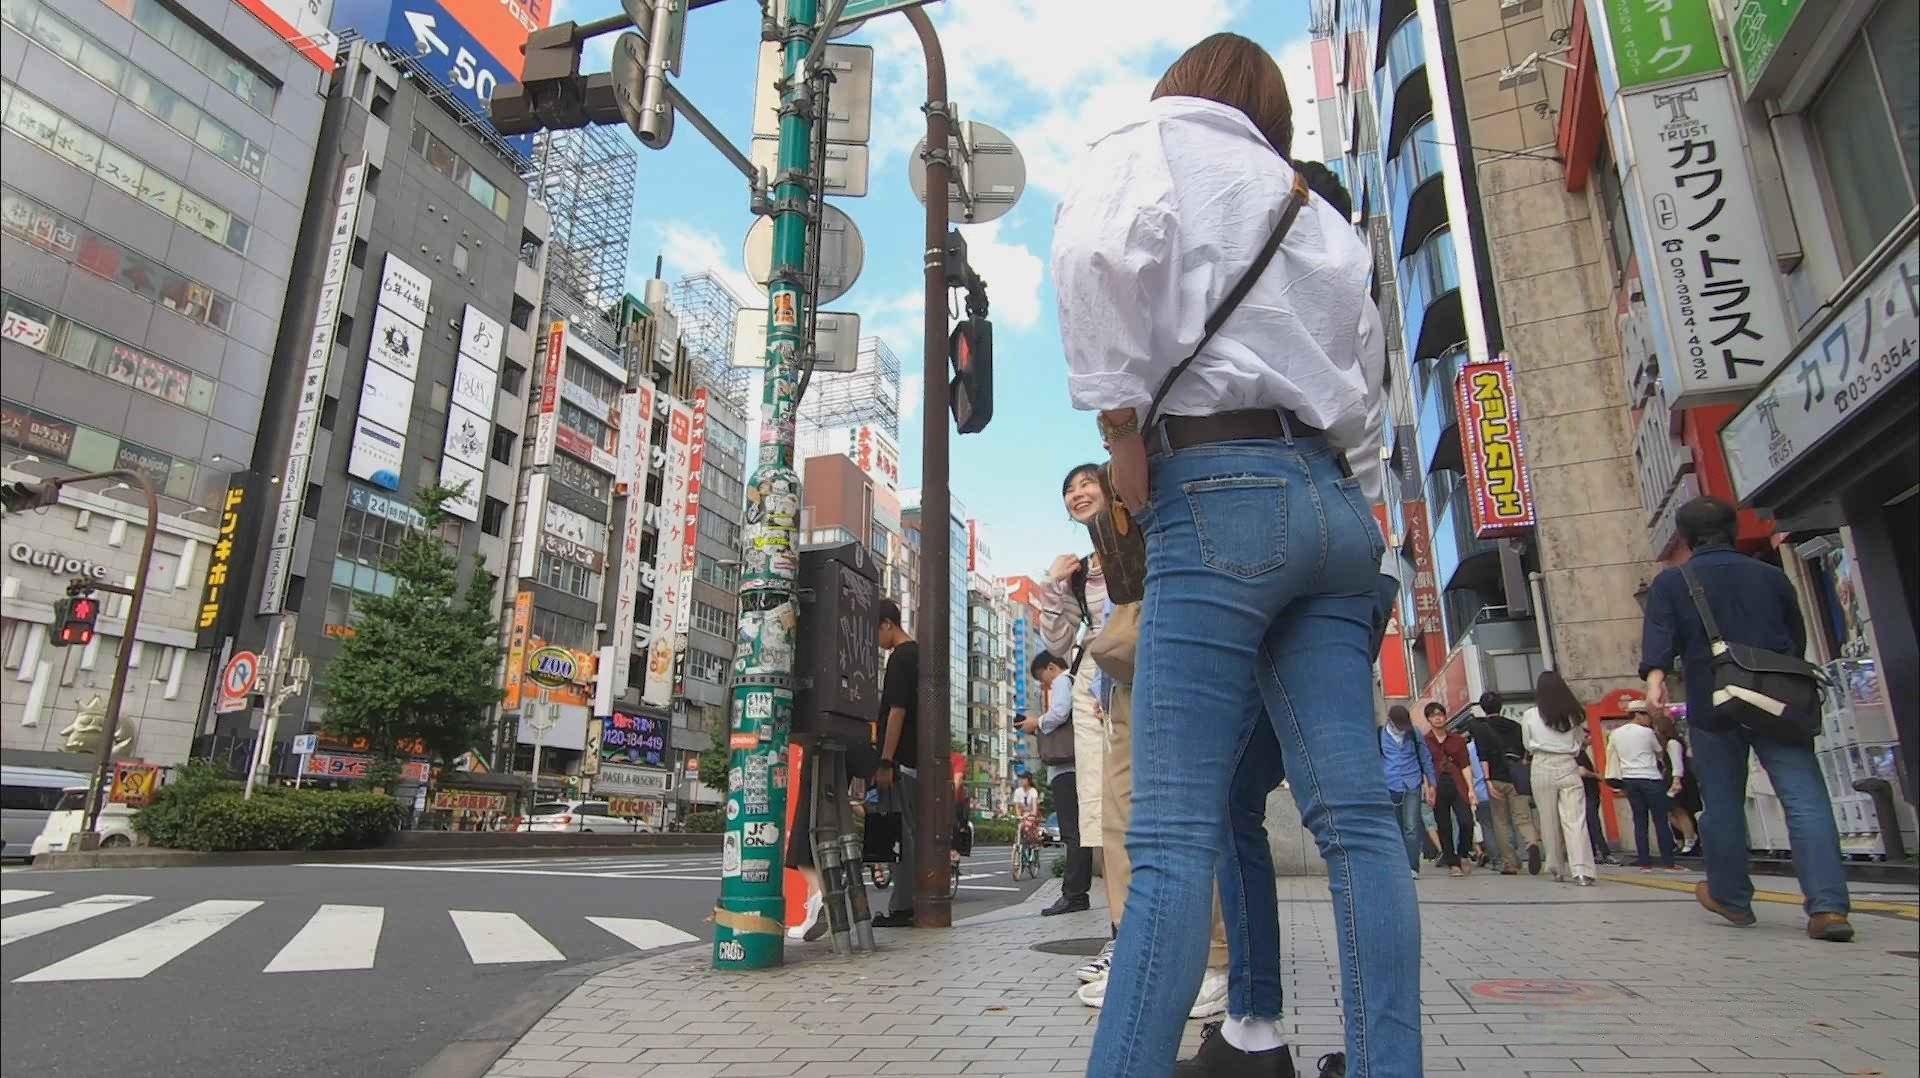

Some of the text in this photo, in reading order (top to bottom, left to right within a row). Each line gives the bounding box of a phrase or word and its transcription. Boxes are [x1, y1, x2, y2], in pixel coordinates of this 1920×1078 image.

[1658, 125, 1708, 142] TRUST
[1668, 140, 1765, 379] カワノ・トラスト
[4, 315, 49, 347] ステージ
[1768, 440, 1793, 469] TRUST
[670, 450, 687, 542] カラオケ
[10, 542, 108, 579] Quijote
[200, 488, 243, 627] ドン・キホーテ
[664, 562, 680, 633] パセラ
